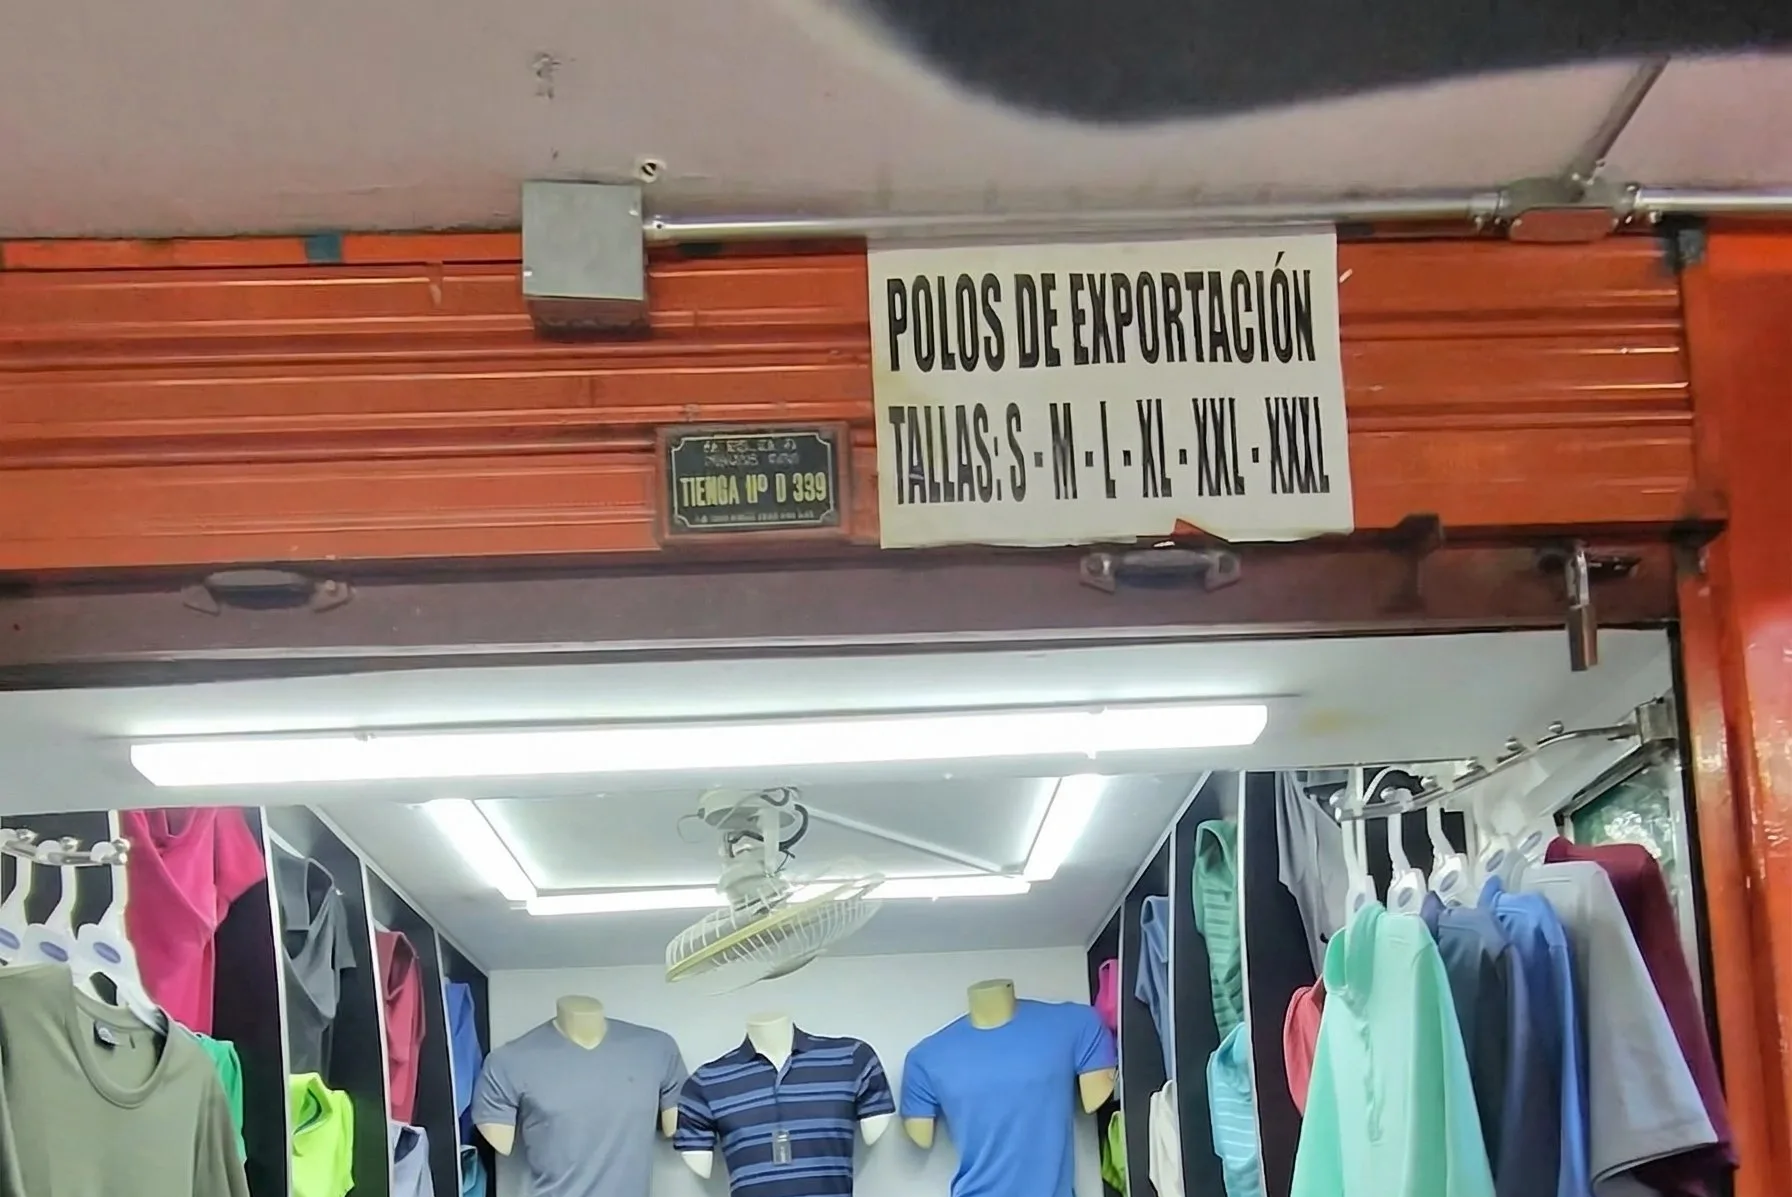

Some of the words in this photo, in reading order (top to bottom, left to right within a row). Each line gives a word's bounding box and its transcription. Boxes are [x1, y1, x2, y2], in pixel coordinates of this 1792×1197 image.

[886, 272, 1003, 373] POLOS
[1014, 272, 1061, 369] DE
[1068, 251, 1316, 366] EXPORTACIÓN
[888, 402, 1003, 505] TALLAS:
[1005, 402, 1027, 503] S
[1049, 402, 1078, 500] M
[1099, 400, 1117, 499] L
[1136, 398, 1173, 498] XL
[1191, 397, 1246, 498] XXL
[1264, 396, 1331, 495] XXXL
